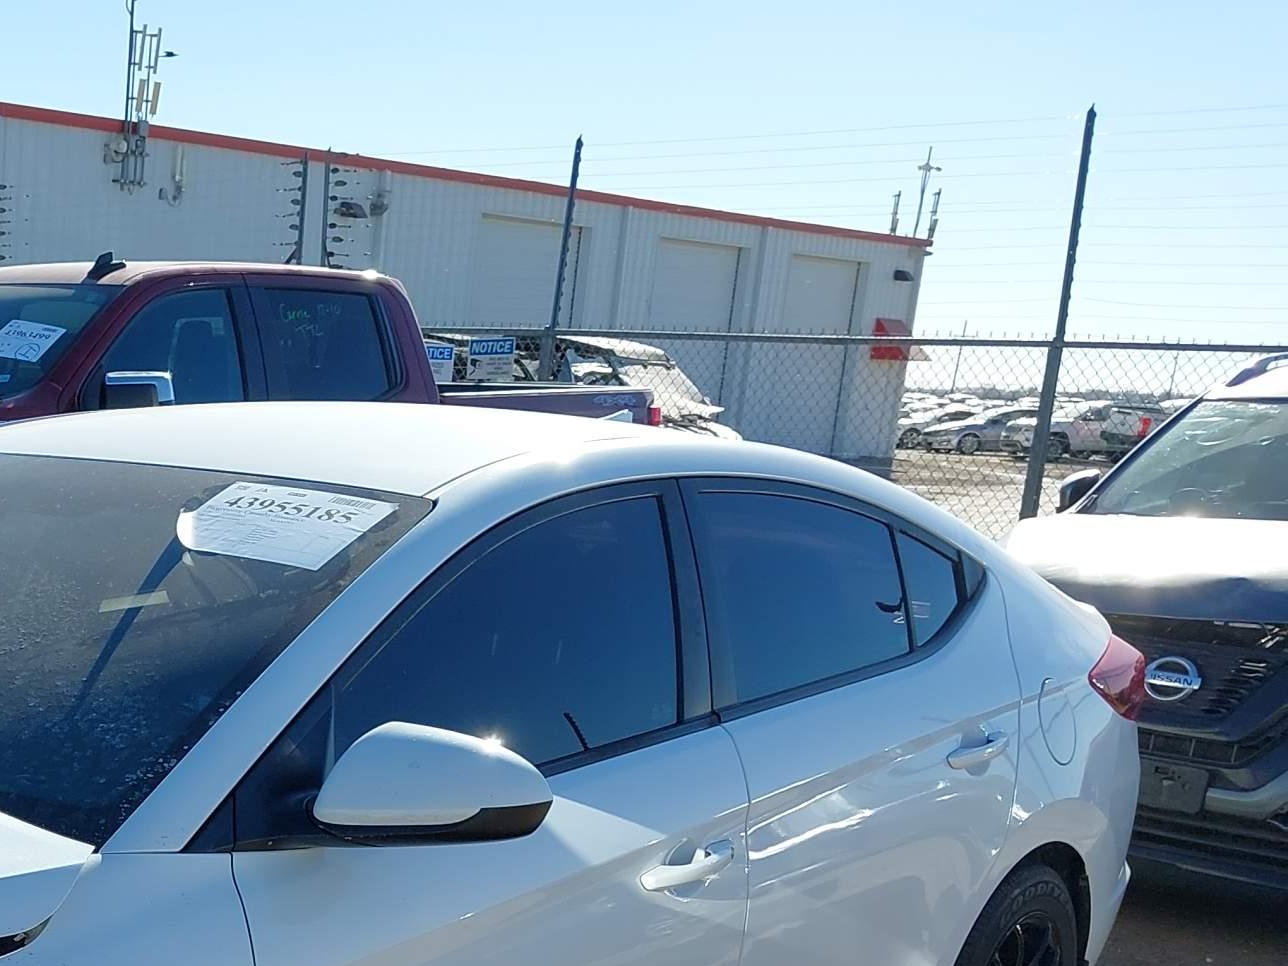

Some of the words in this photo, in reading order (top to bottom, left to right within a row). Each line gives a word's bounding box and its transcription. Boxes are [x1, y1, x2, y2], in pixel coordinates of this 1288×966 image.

[428, 347, 451, 358] TICE
[472, 341, 512, 353] NOTICE
[224, 495, 362, 525] 43955185
[1150, 672, 1193, 687] ISSAN
